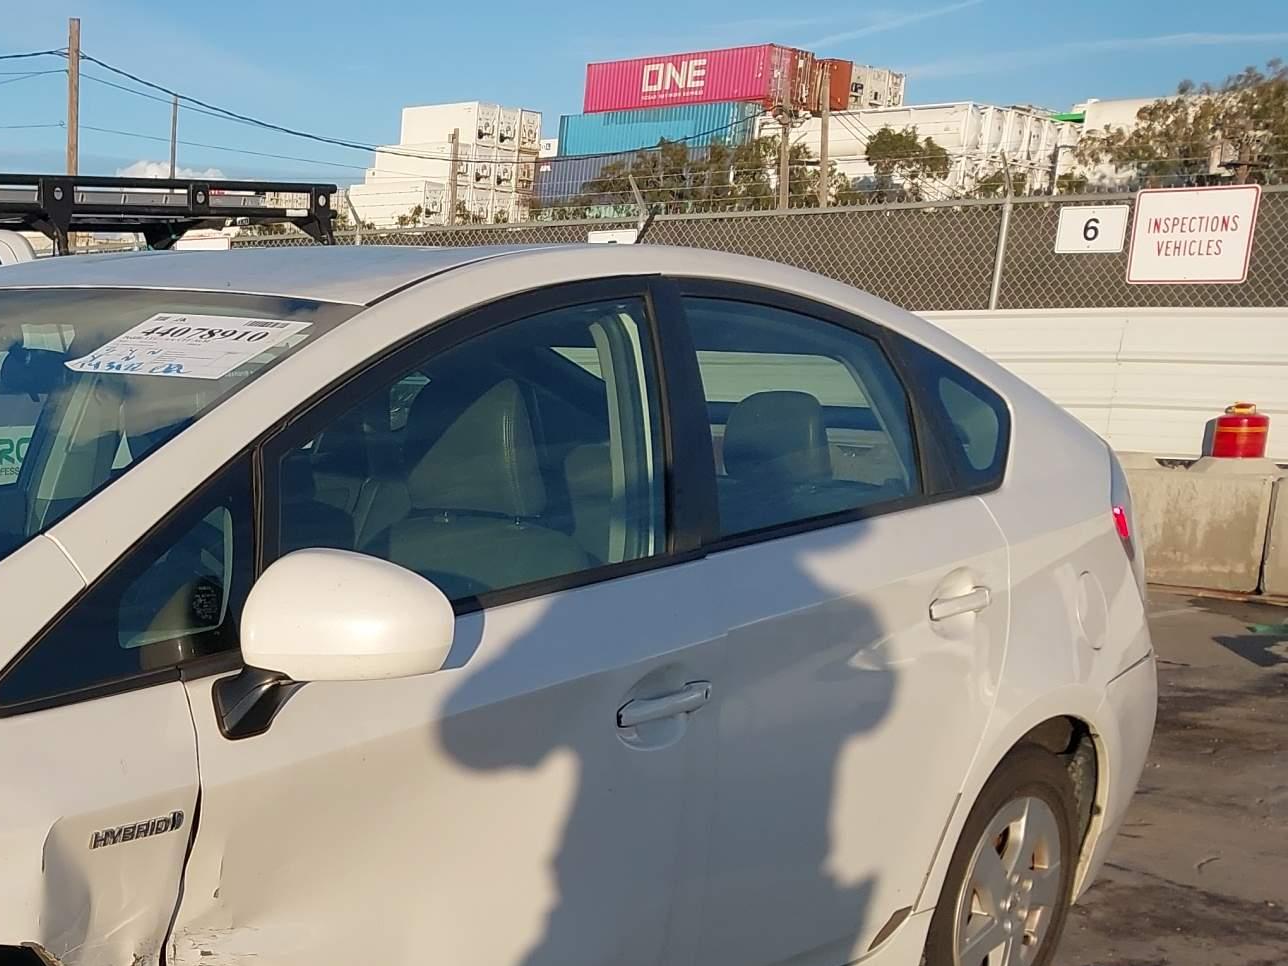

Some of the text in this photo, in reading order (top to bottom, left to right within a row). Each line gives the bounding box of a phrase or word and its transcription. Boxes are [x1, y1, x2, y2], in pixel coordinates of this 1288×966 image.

[642, 58, 707, 92] ONE
[1083, 217, 1100, 241] 6
[1147, 214, 1240, 234] INSPECTIONS
[1156, 239, 1223, 257] VEHICLES
[141, 325, 269, 343] 44078910
[89, 817, 171, 849] HYBRID
